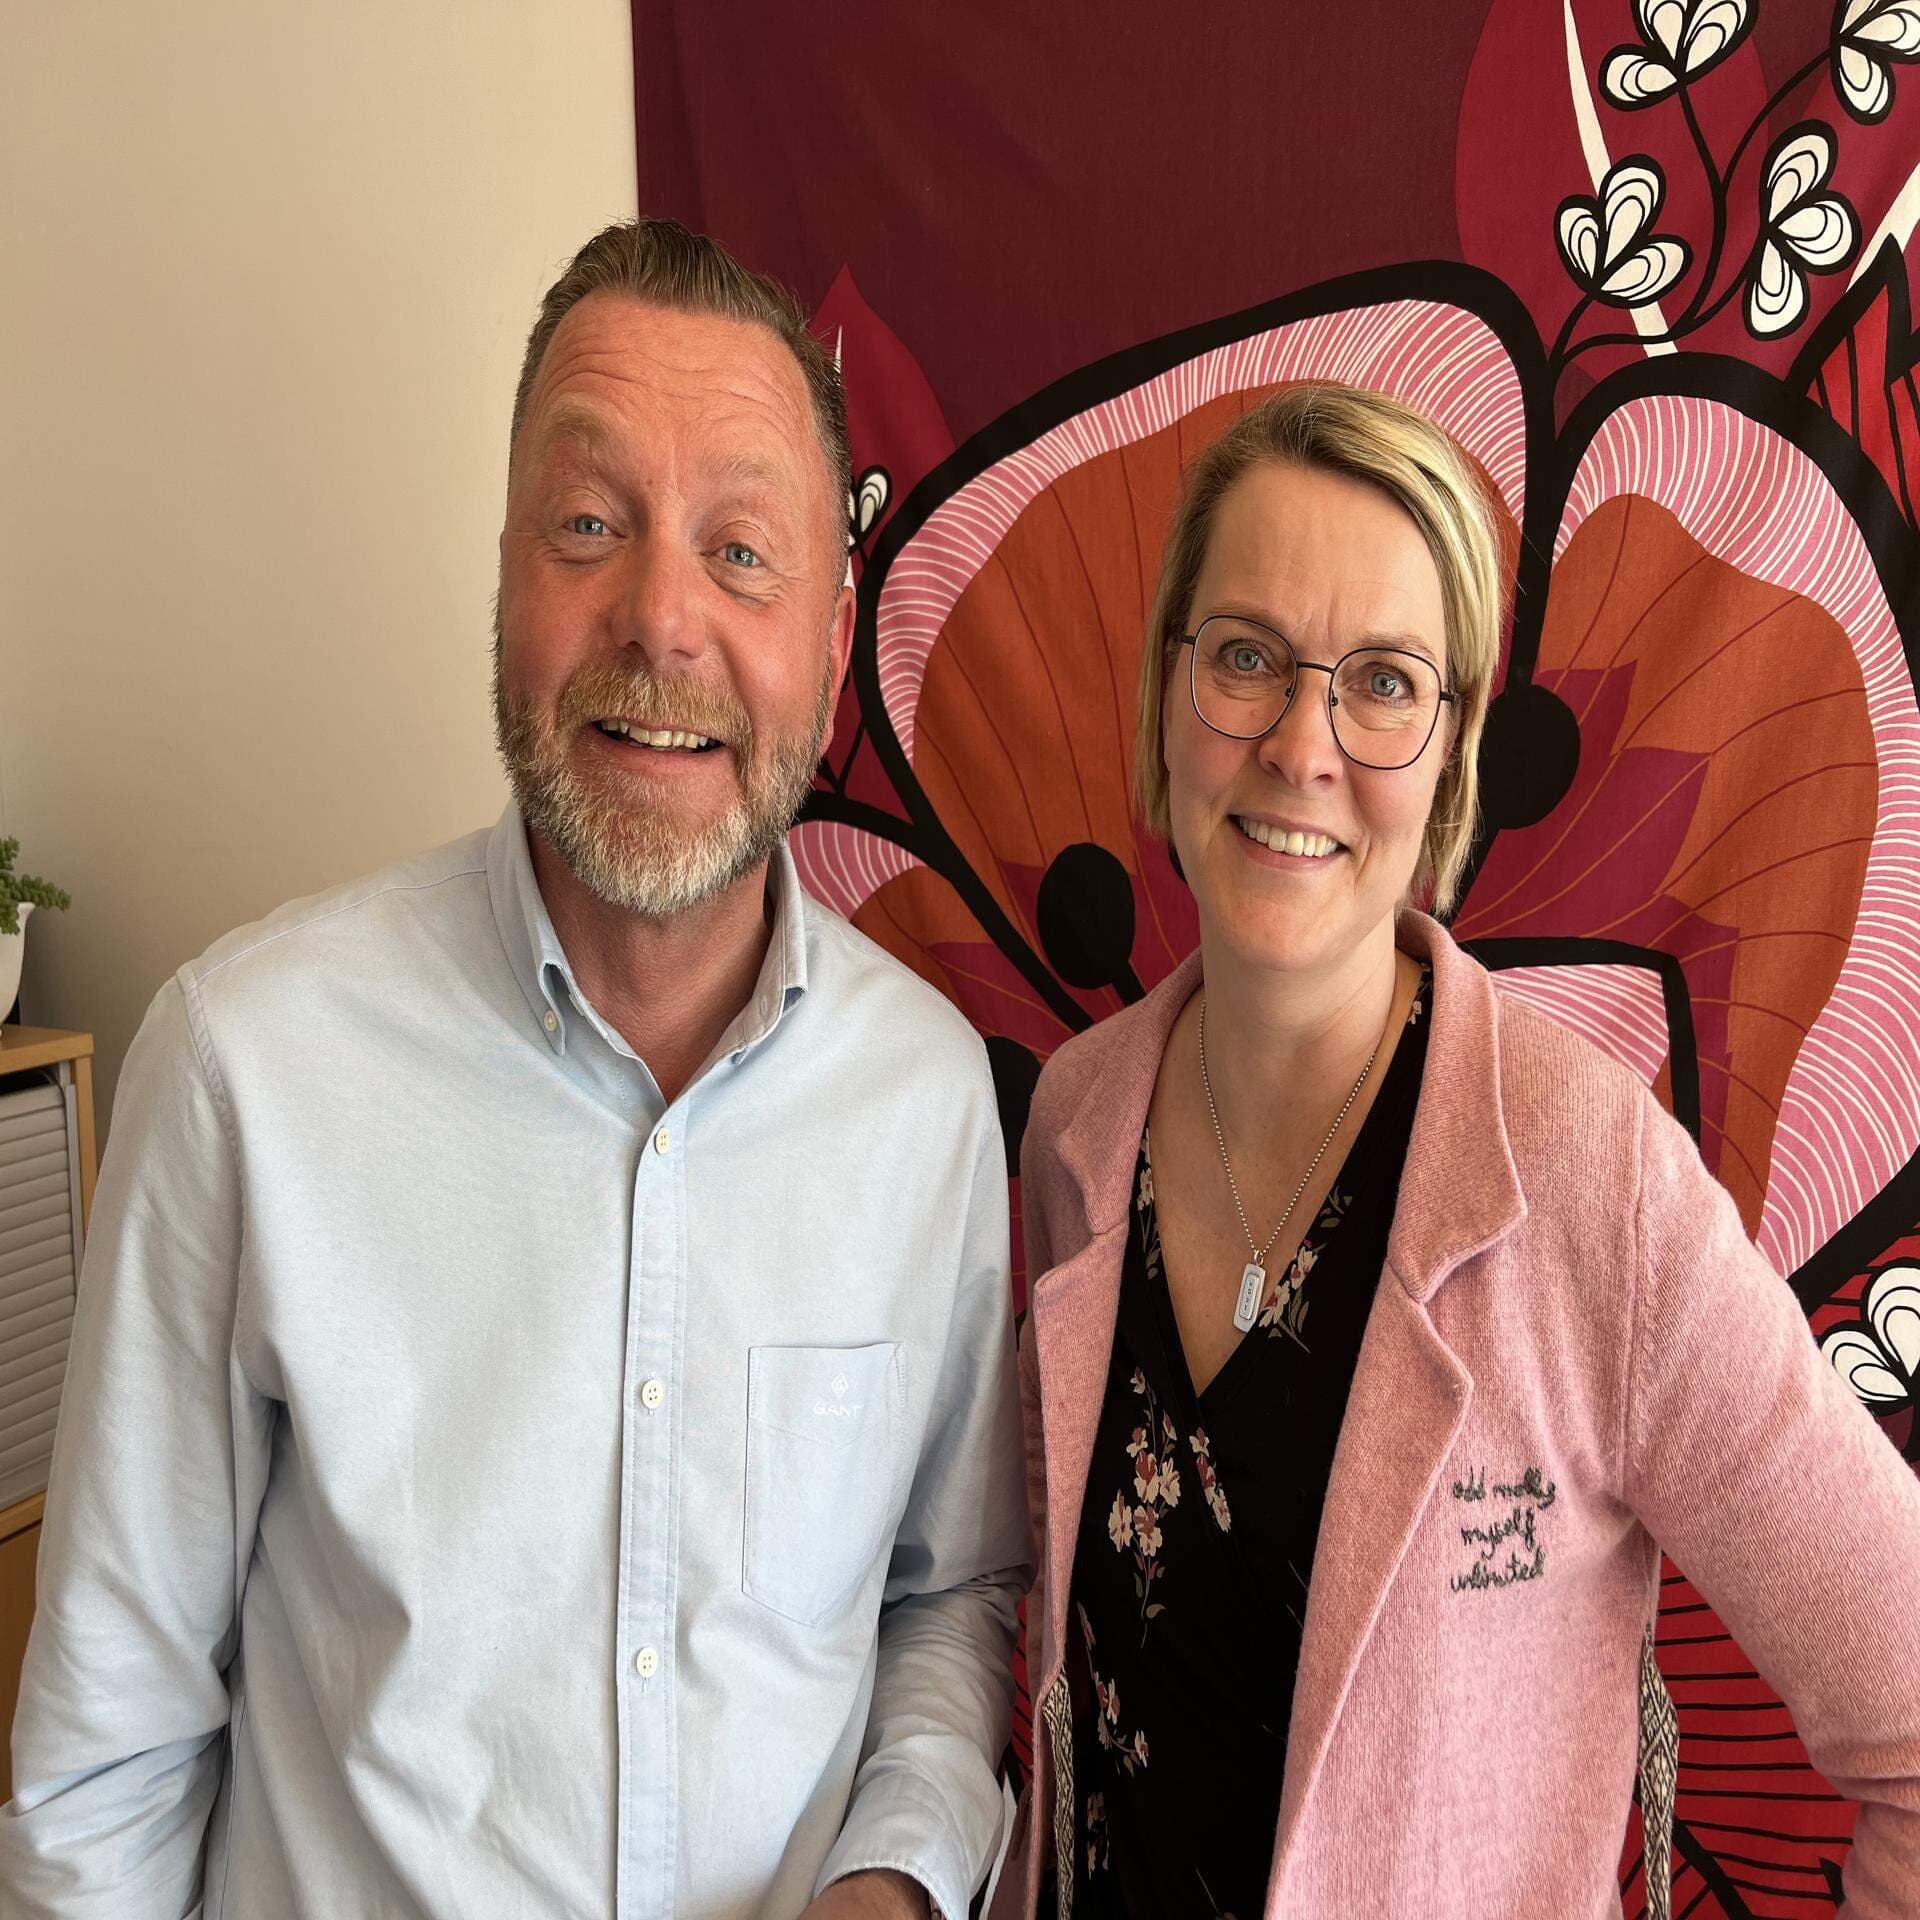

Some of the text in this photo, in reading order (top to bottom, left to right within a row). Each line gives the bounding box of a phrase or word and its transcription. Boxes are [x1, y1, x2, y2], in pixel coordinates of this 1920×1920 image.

[814, 1402, 863, 1417] GANT
[1453, 1466, 1556, 1510] odd molly
[1461, 1506, 1536, 1560] myself
